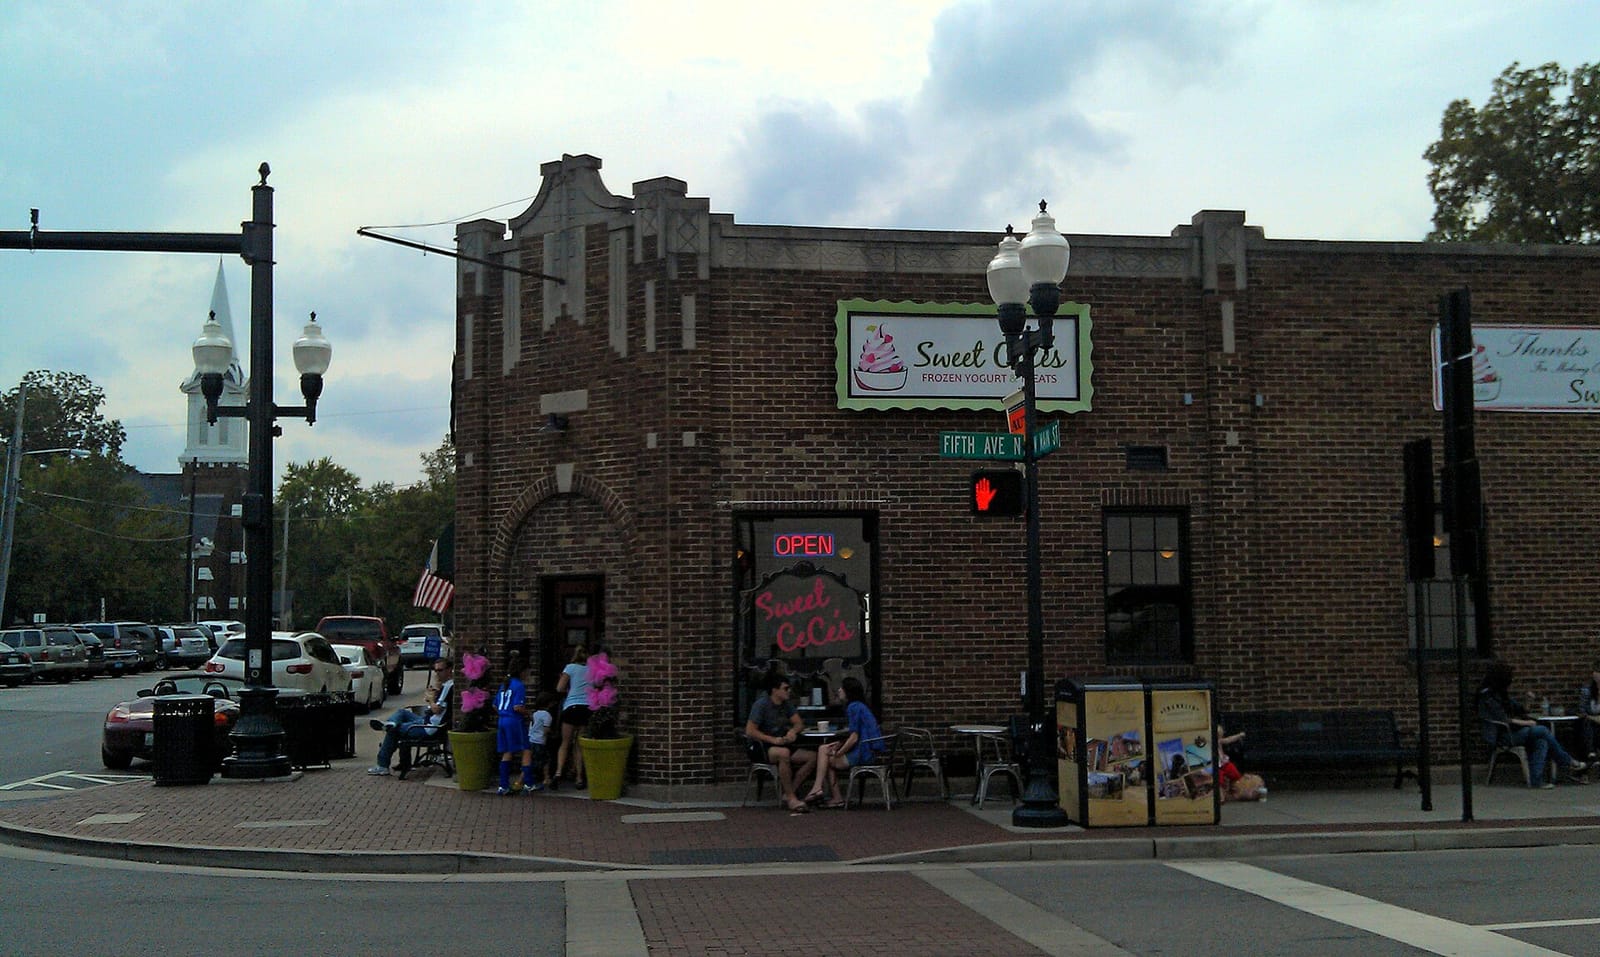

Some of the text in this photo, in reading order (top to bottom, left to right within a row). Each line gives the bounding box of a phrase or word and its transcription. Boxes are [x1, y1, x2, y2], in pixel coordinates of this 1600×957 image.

[913, 340, 986, 368] Sweet
[1497, 332, 1589, 357] Thanks
[922, 373, 962, 383] FROZEN
[965, 374, 1007, 384] YOGURT
[943, 435, 975, 454] FIFTH
[983, 436, 1005, 455] AVE
[1013, 437, 1021, 456] N
[775, 535, 832, 555] OPEN
[756, 577, 829, 620] Sweet
[777, 609, 854, 652] CeCe's
